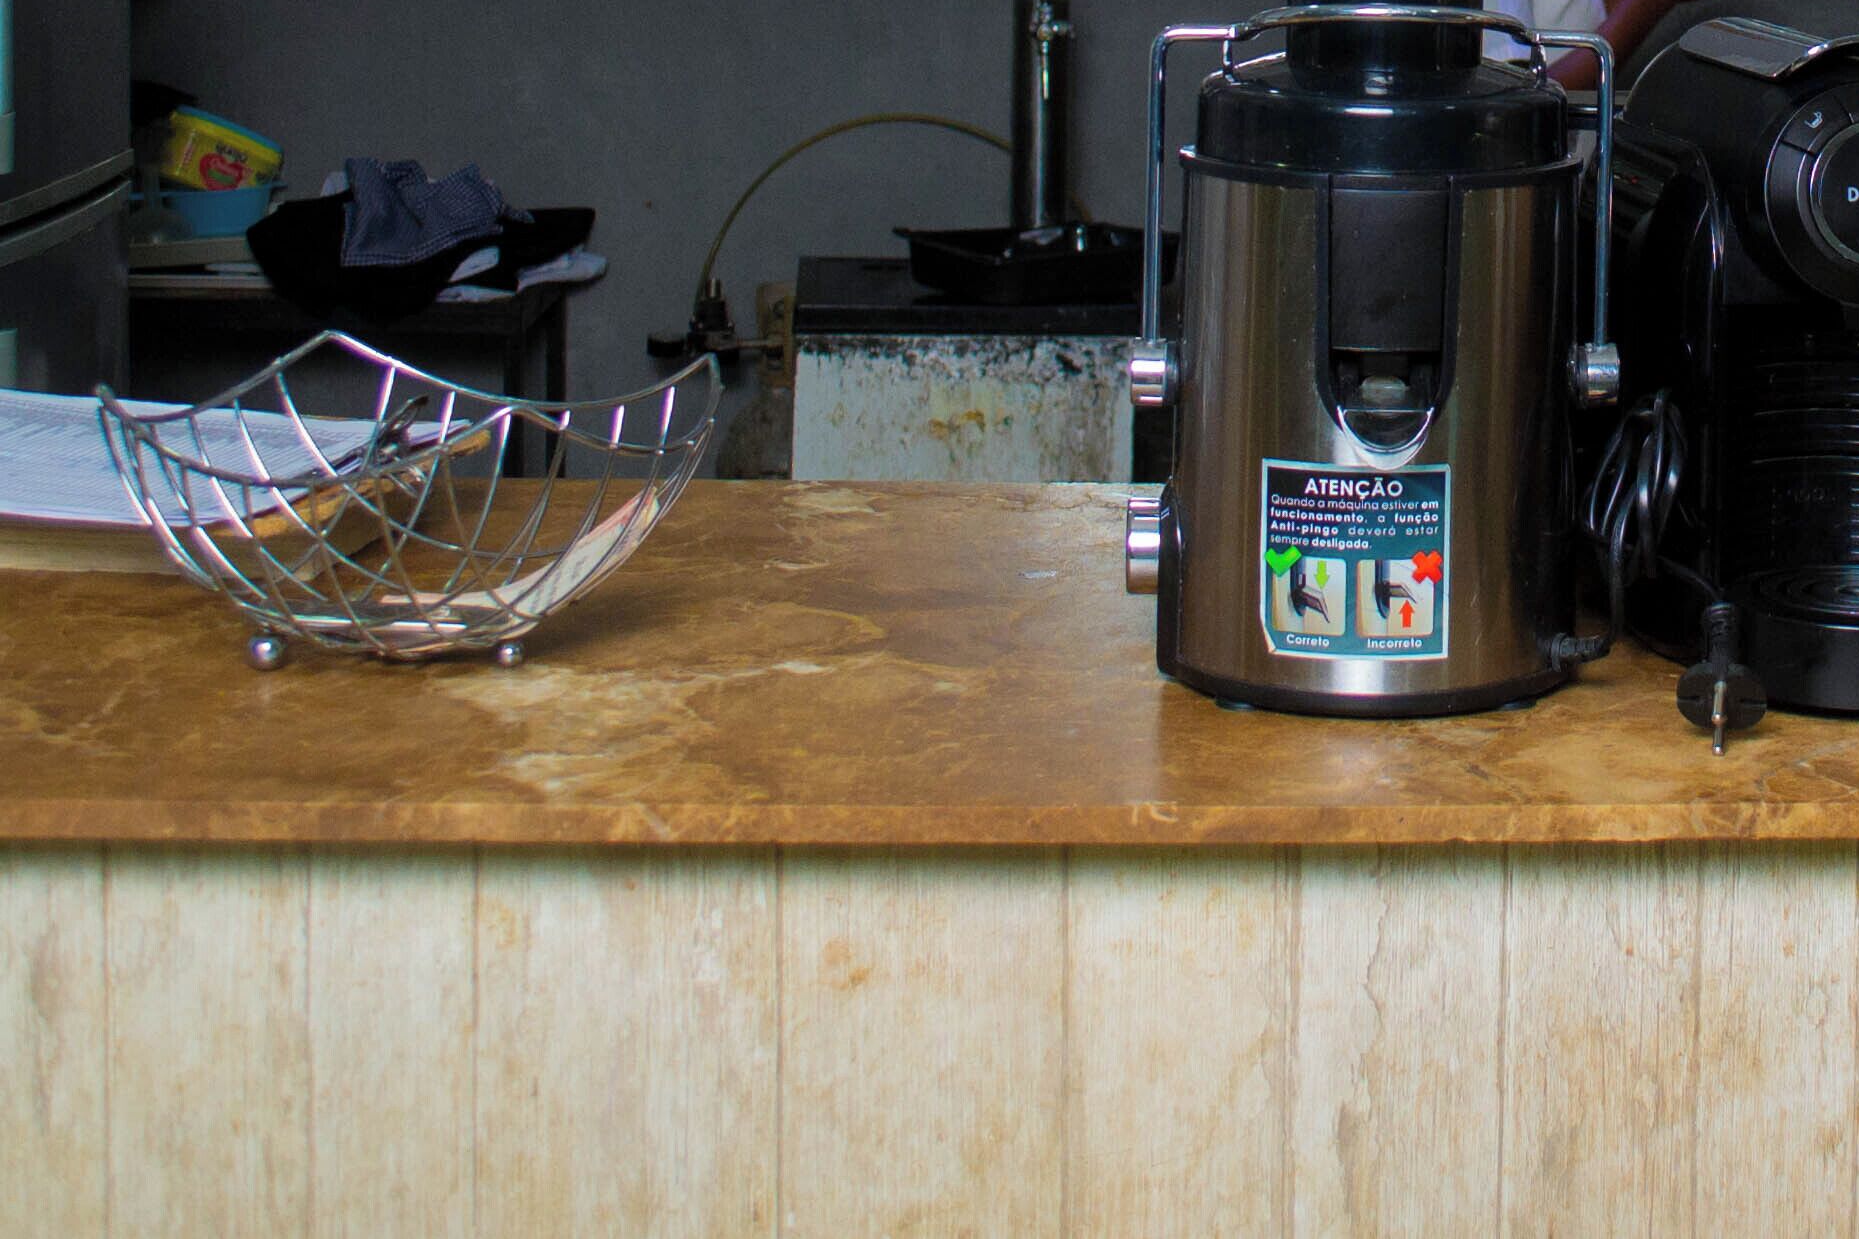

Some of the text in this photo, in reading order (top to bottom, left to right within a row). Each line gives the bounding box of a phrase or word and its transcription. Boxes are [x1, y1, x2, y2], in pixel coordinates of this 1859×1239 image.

[1305, 477, 1403, 501] ATENÇÃO
[1271, 494, 1439, 512] Quando a máquina estiver em
[1377, 514, 1386, 523] a
[1394, 512, 1439, 525] função
[1270, 521, 1439, 537] Anti-pingo deverá estar
[1270, 534, 1373, 552] sempre desligada.
[1286, 633, 1422, 649] Correto Incorreto
